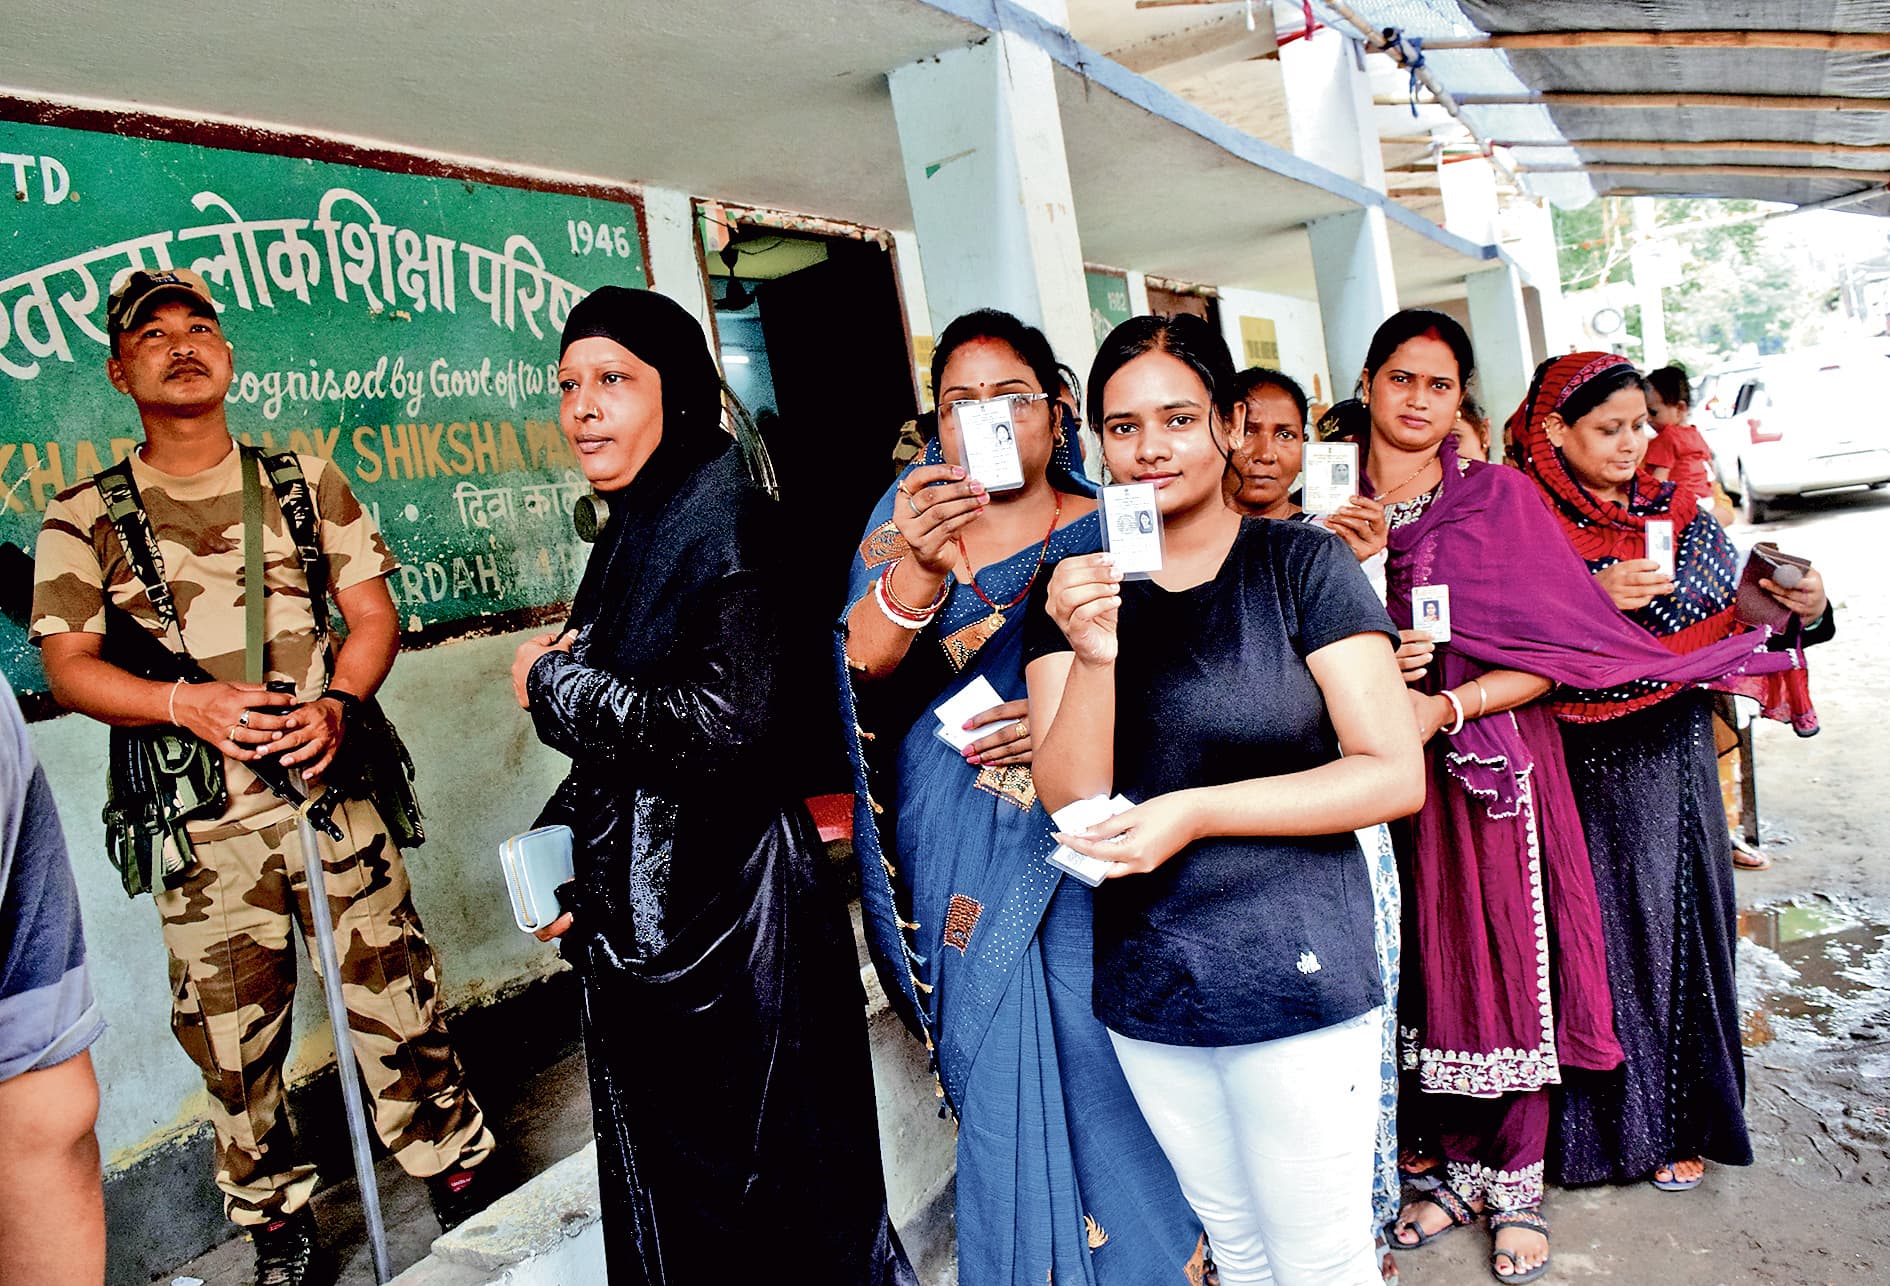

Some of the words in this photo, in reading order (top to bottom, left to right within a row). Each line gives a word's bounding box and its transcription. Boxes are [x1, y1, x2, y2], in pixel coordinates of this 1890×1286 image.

[313, 188, 456, 314] शिक्षा
[567, 219, 630, 258] 1946
[390, 356, 424, 417] by
[495, 359, 517, 408] of
[352, 421, 527, 483] SHIKSHA
